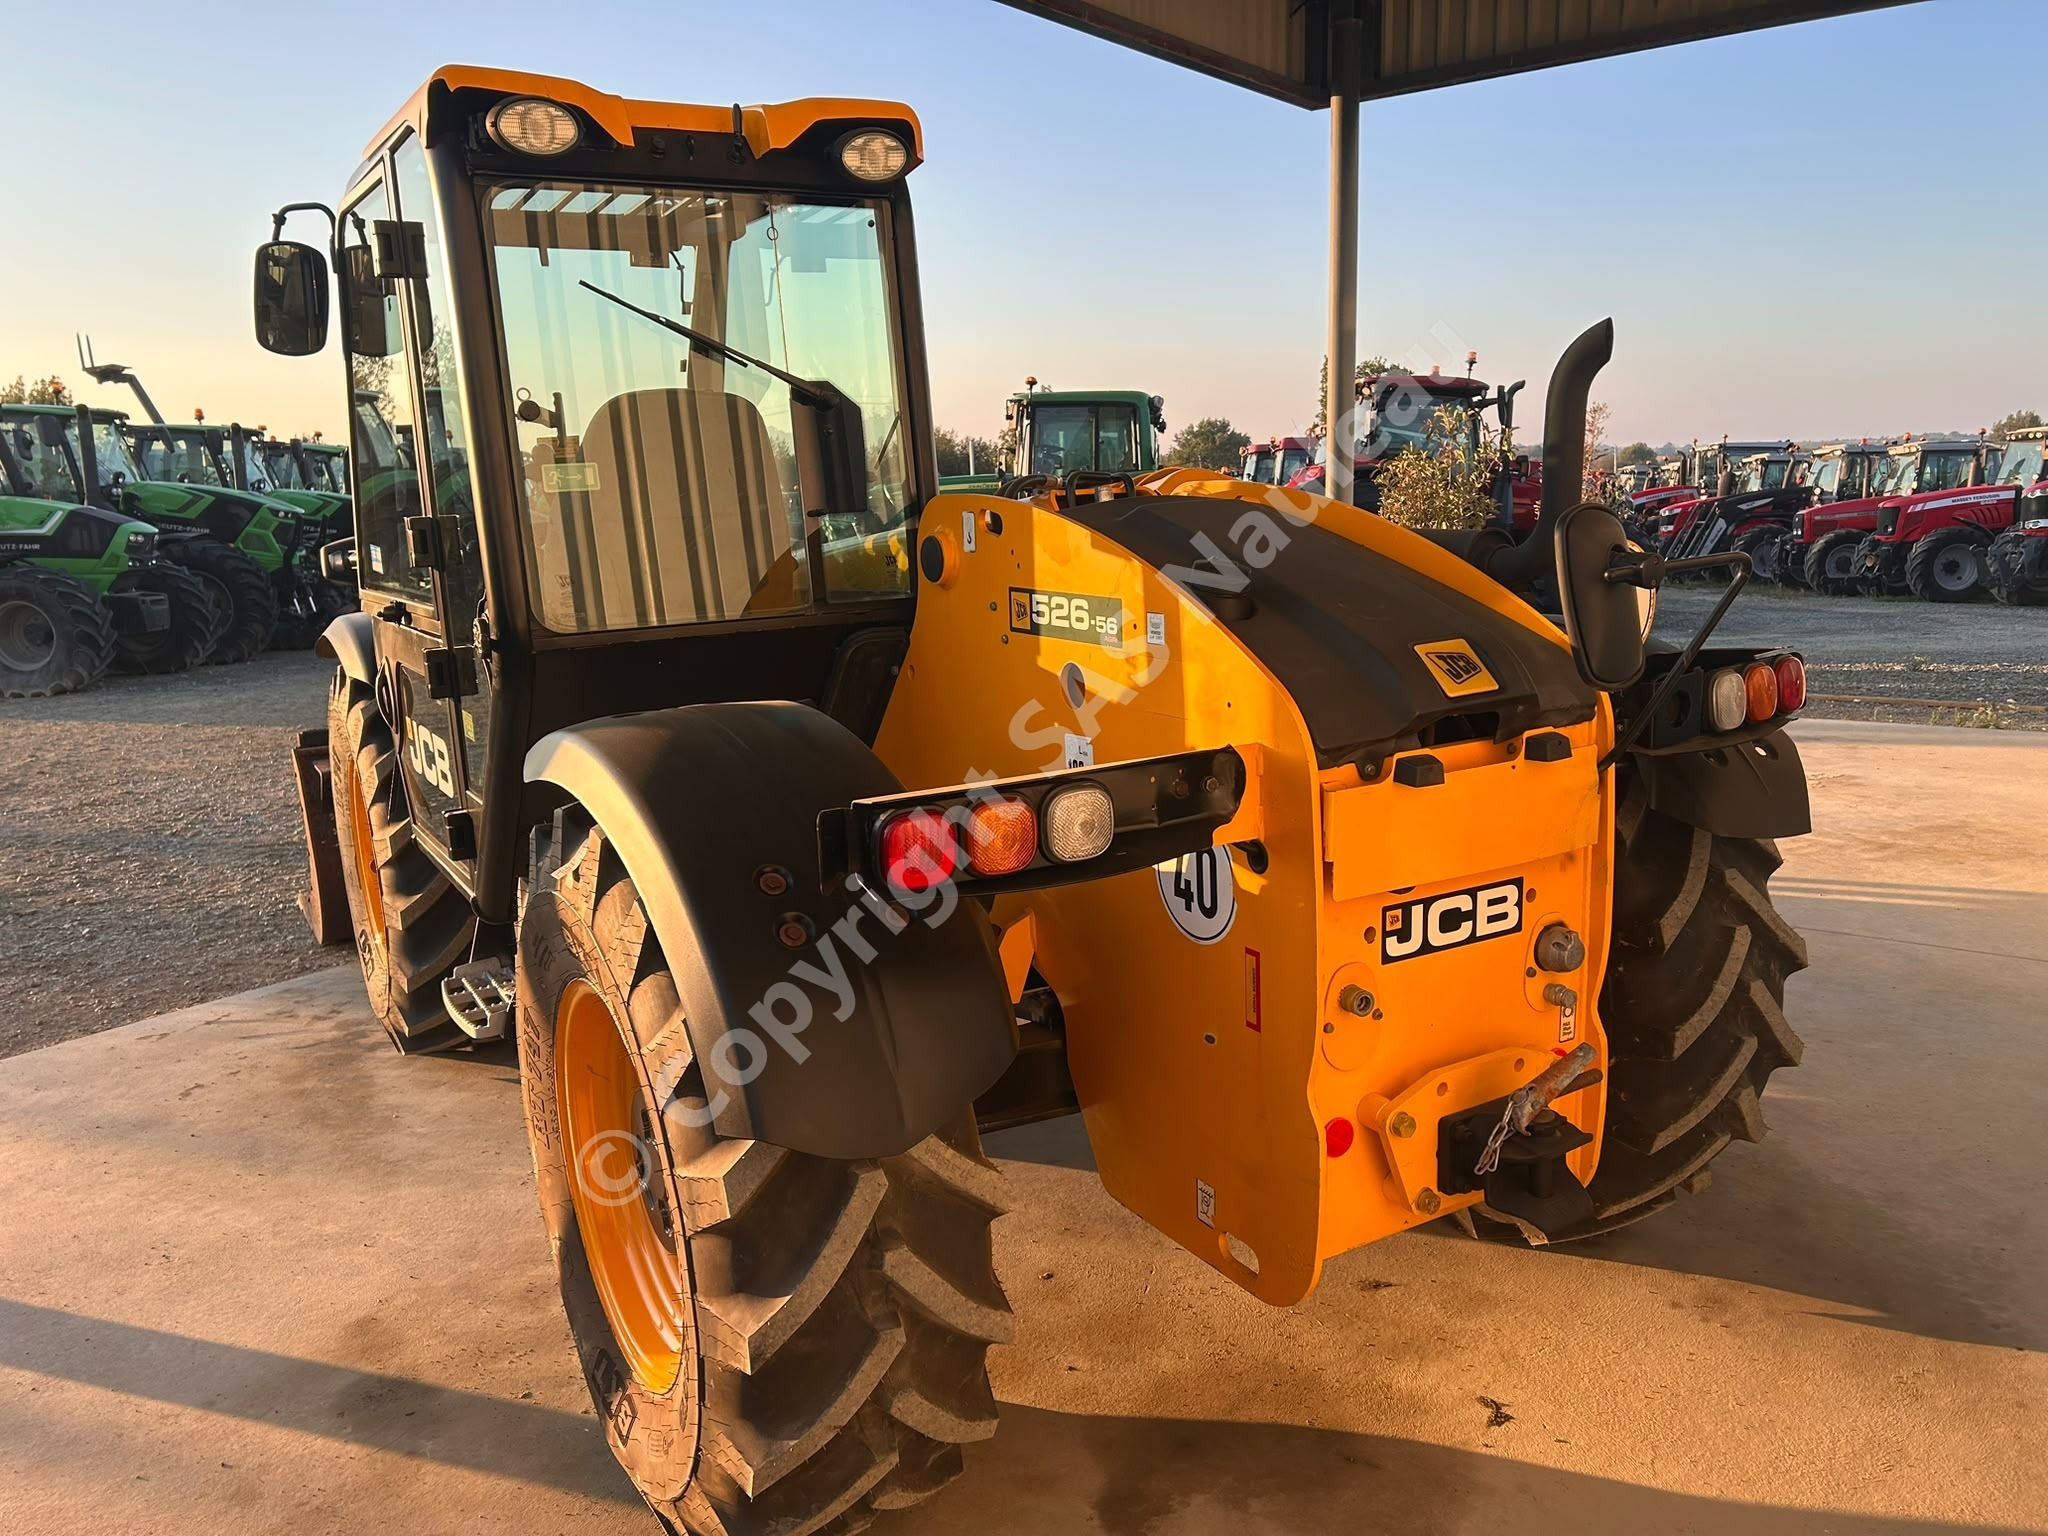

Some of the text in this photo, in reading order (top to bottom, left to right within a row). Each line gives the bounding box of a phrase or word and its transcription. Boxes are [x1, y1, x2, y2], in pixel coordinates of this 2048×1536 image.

[1432, 652, 1480, 682] JCB
[409, 720, 454, 798] JCB
[1173, 849, 1218, 920] 40
[1385, 884, 1520, 957] JCB
